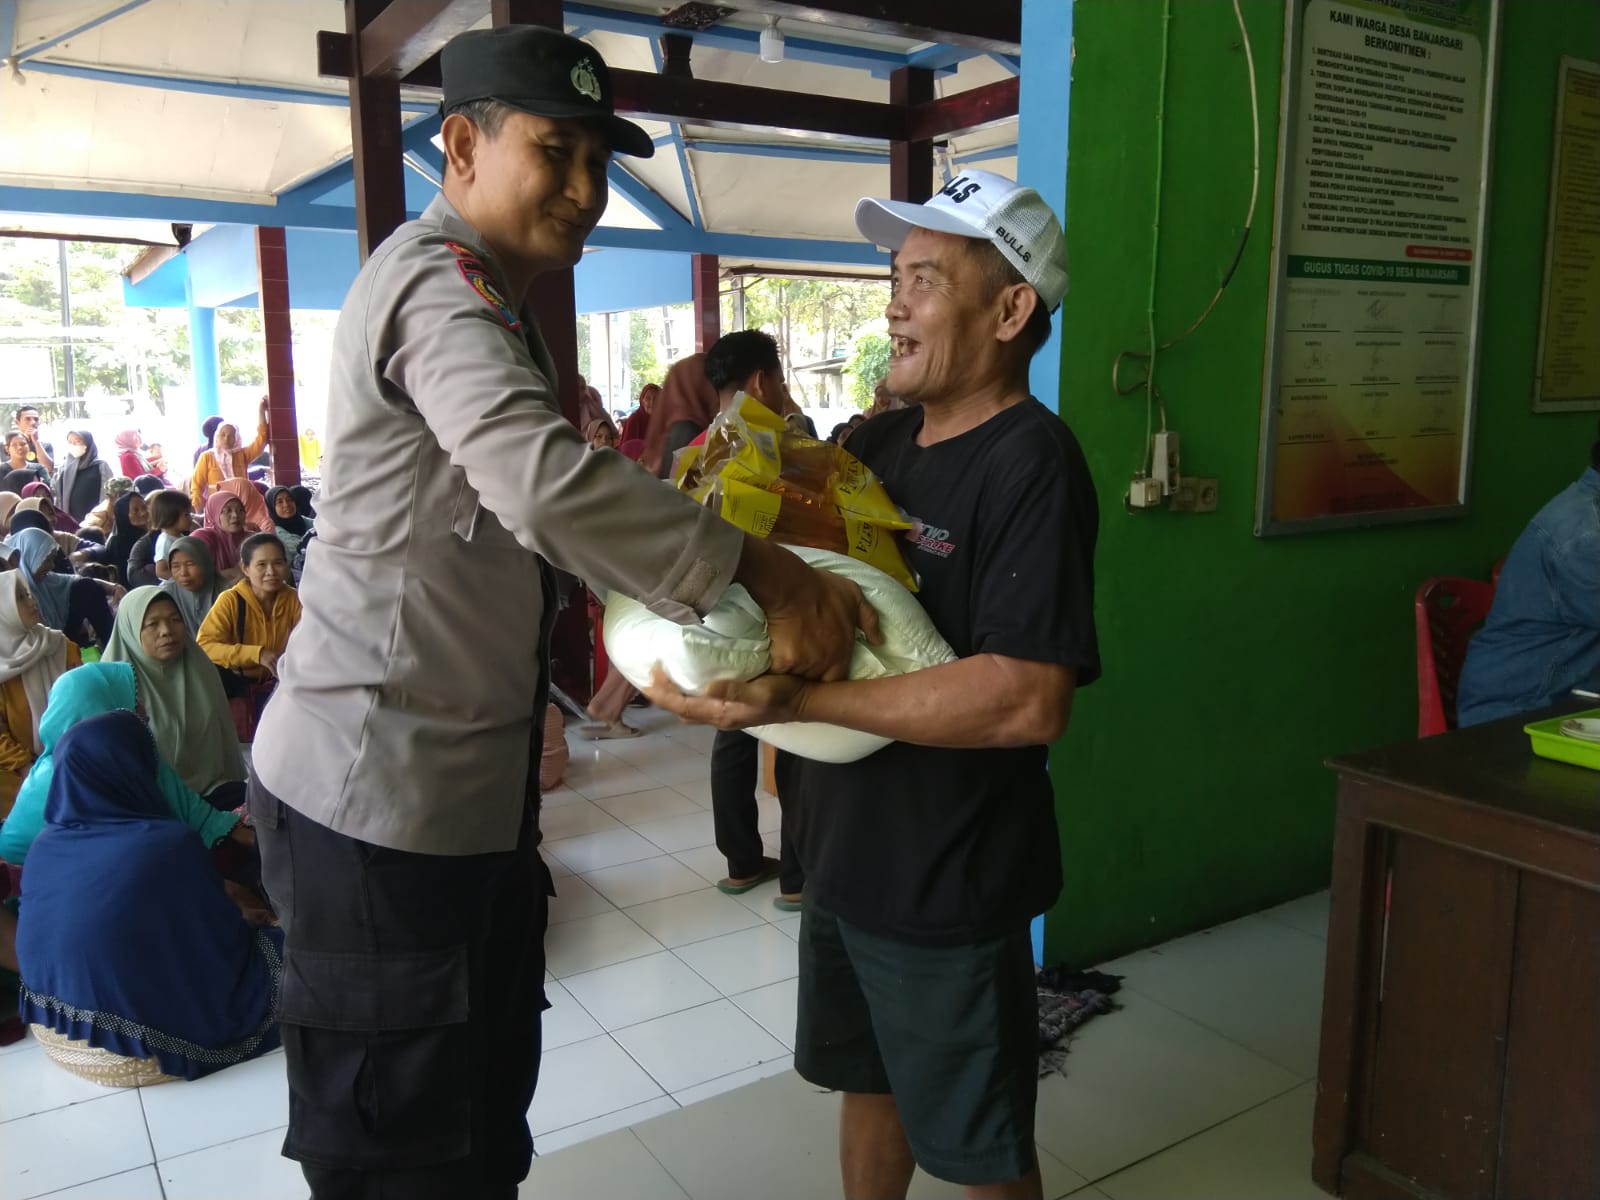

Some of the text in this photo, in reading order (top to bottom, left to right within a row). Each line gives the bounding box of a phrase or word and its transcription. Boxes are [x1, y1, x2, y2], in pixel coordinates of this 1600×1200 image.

[1330, 10, 1353, 26] KAMI
[1355, 16, 1387, 34] WARGA
[1389, 24, 1411, 39] DESA
[1413, 28, 1463, 50] BANJARSARI
[1364, 35, 1426, 59] BERKOMITMEN
[996, 226, 1031, 263] BULLS
[1304, 262, 1459, 281] GUGUS TUGAS COVID-19 DESA BANJARSARI
